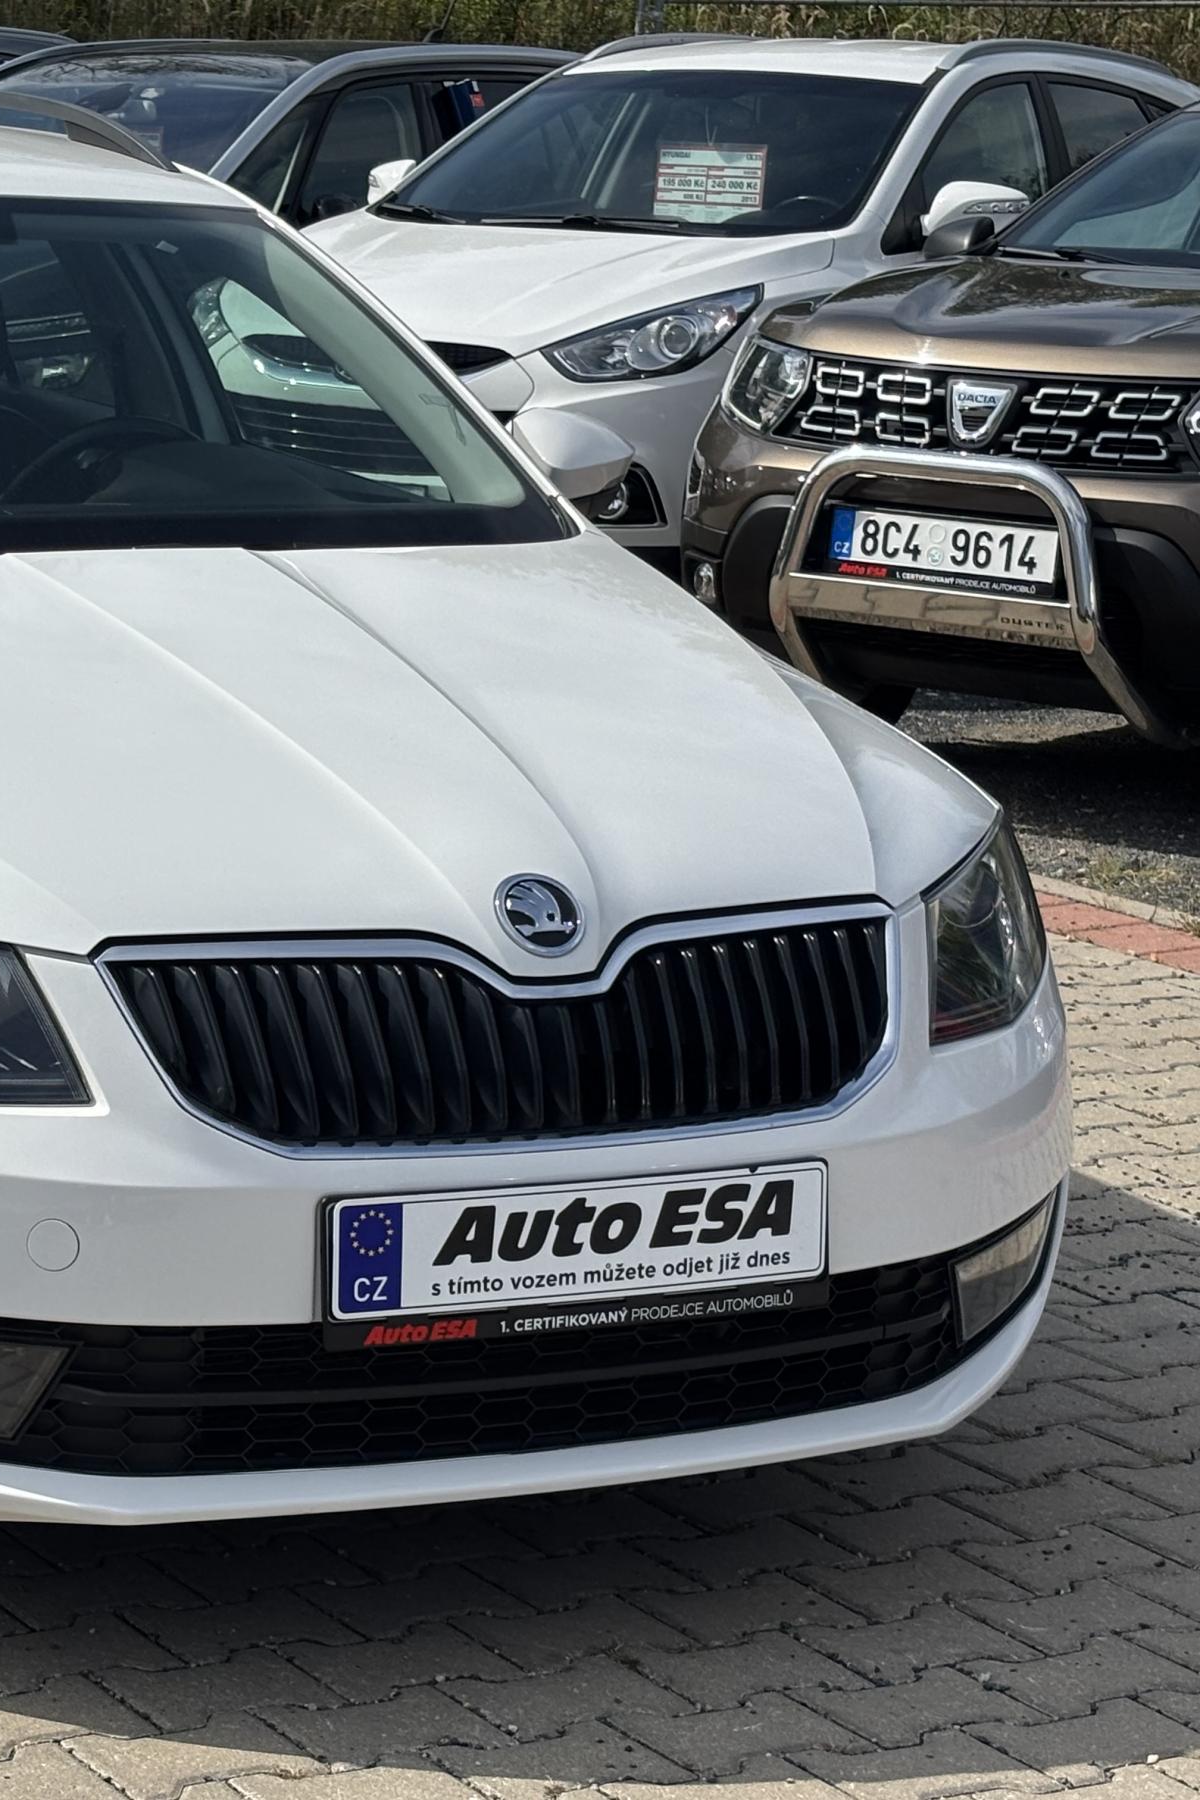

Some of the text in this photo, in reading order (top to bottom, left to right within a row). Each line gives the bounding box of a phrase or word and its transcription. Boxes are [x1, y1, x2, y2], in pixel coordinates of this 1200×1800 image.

[662, 151, 691, 159] HYUNDAI
[662, 178, 705, 188] 195 000 Kč
[711, 180, 759, 191] 240 000 Kč
[957, 392, 996, 404] DACIA
[833, 540, 850, 554] CZ
[860, 519, 1038, 575] 8C4 9614
[838, 562, 866, 576] Auto
[902, 571, 954, 585] CERTIFIKOVANÝ
[955, 577, 990, 589] PRODEJCE
[991, 582, 1036, 595] AUTOMOBILŮ
[432, 1179, 794, 1266] Auto ESA
[431, 1250, 791, 1296] s tímto vozem můžete odjet již dnes
[353, 1276, 389, 1302] CZ
[500, 1289, 794, 1334] 1. CERTIFIKOVANÝ PRODEJCE AUTOMOBILŮ
[363, 1318, 478, 1346] Auto ESA
